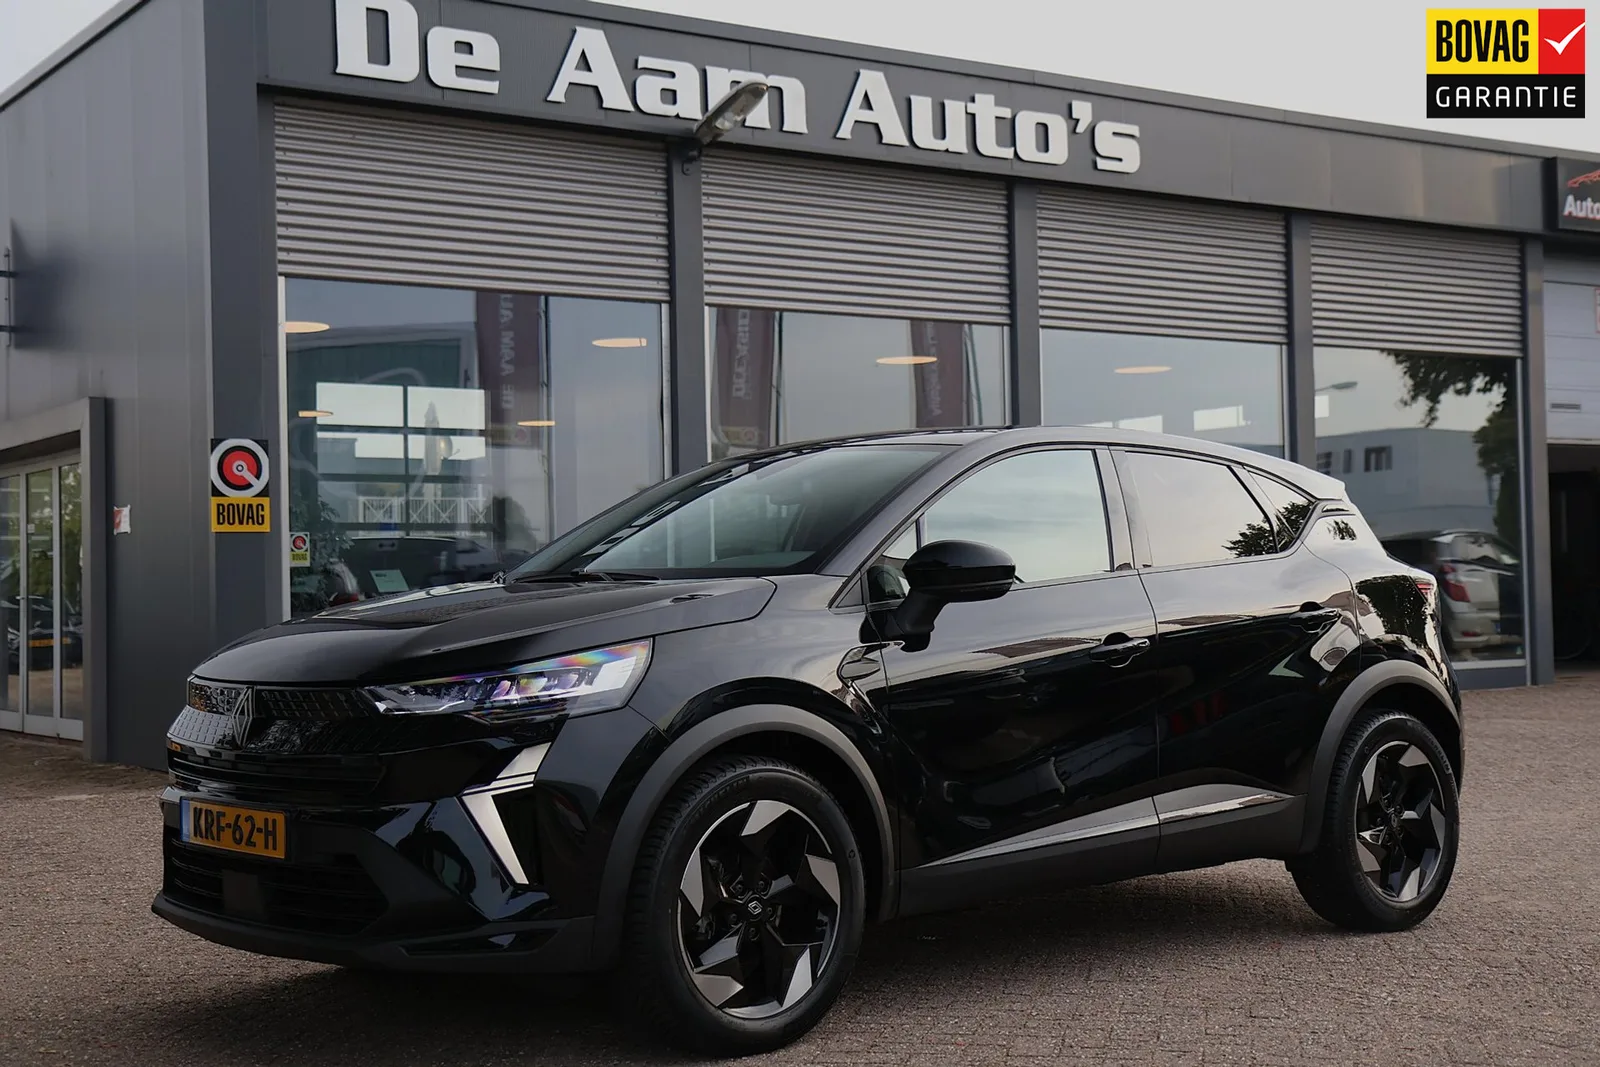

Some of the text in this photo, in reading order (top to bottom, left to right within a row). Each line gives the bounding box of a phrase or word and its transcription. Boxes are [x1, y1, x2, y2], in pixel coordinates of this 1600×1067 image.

[335, 0, 1140, 174] De Aam Auto's
[216, 503, 265, 526] BOVAG
[193, 806, 278, 851] KRF-62-H
